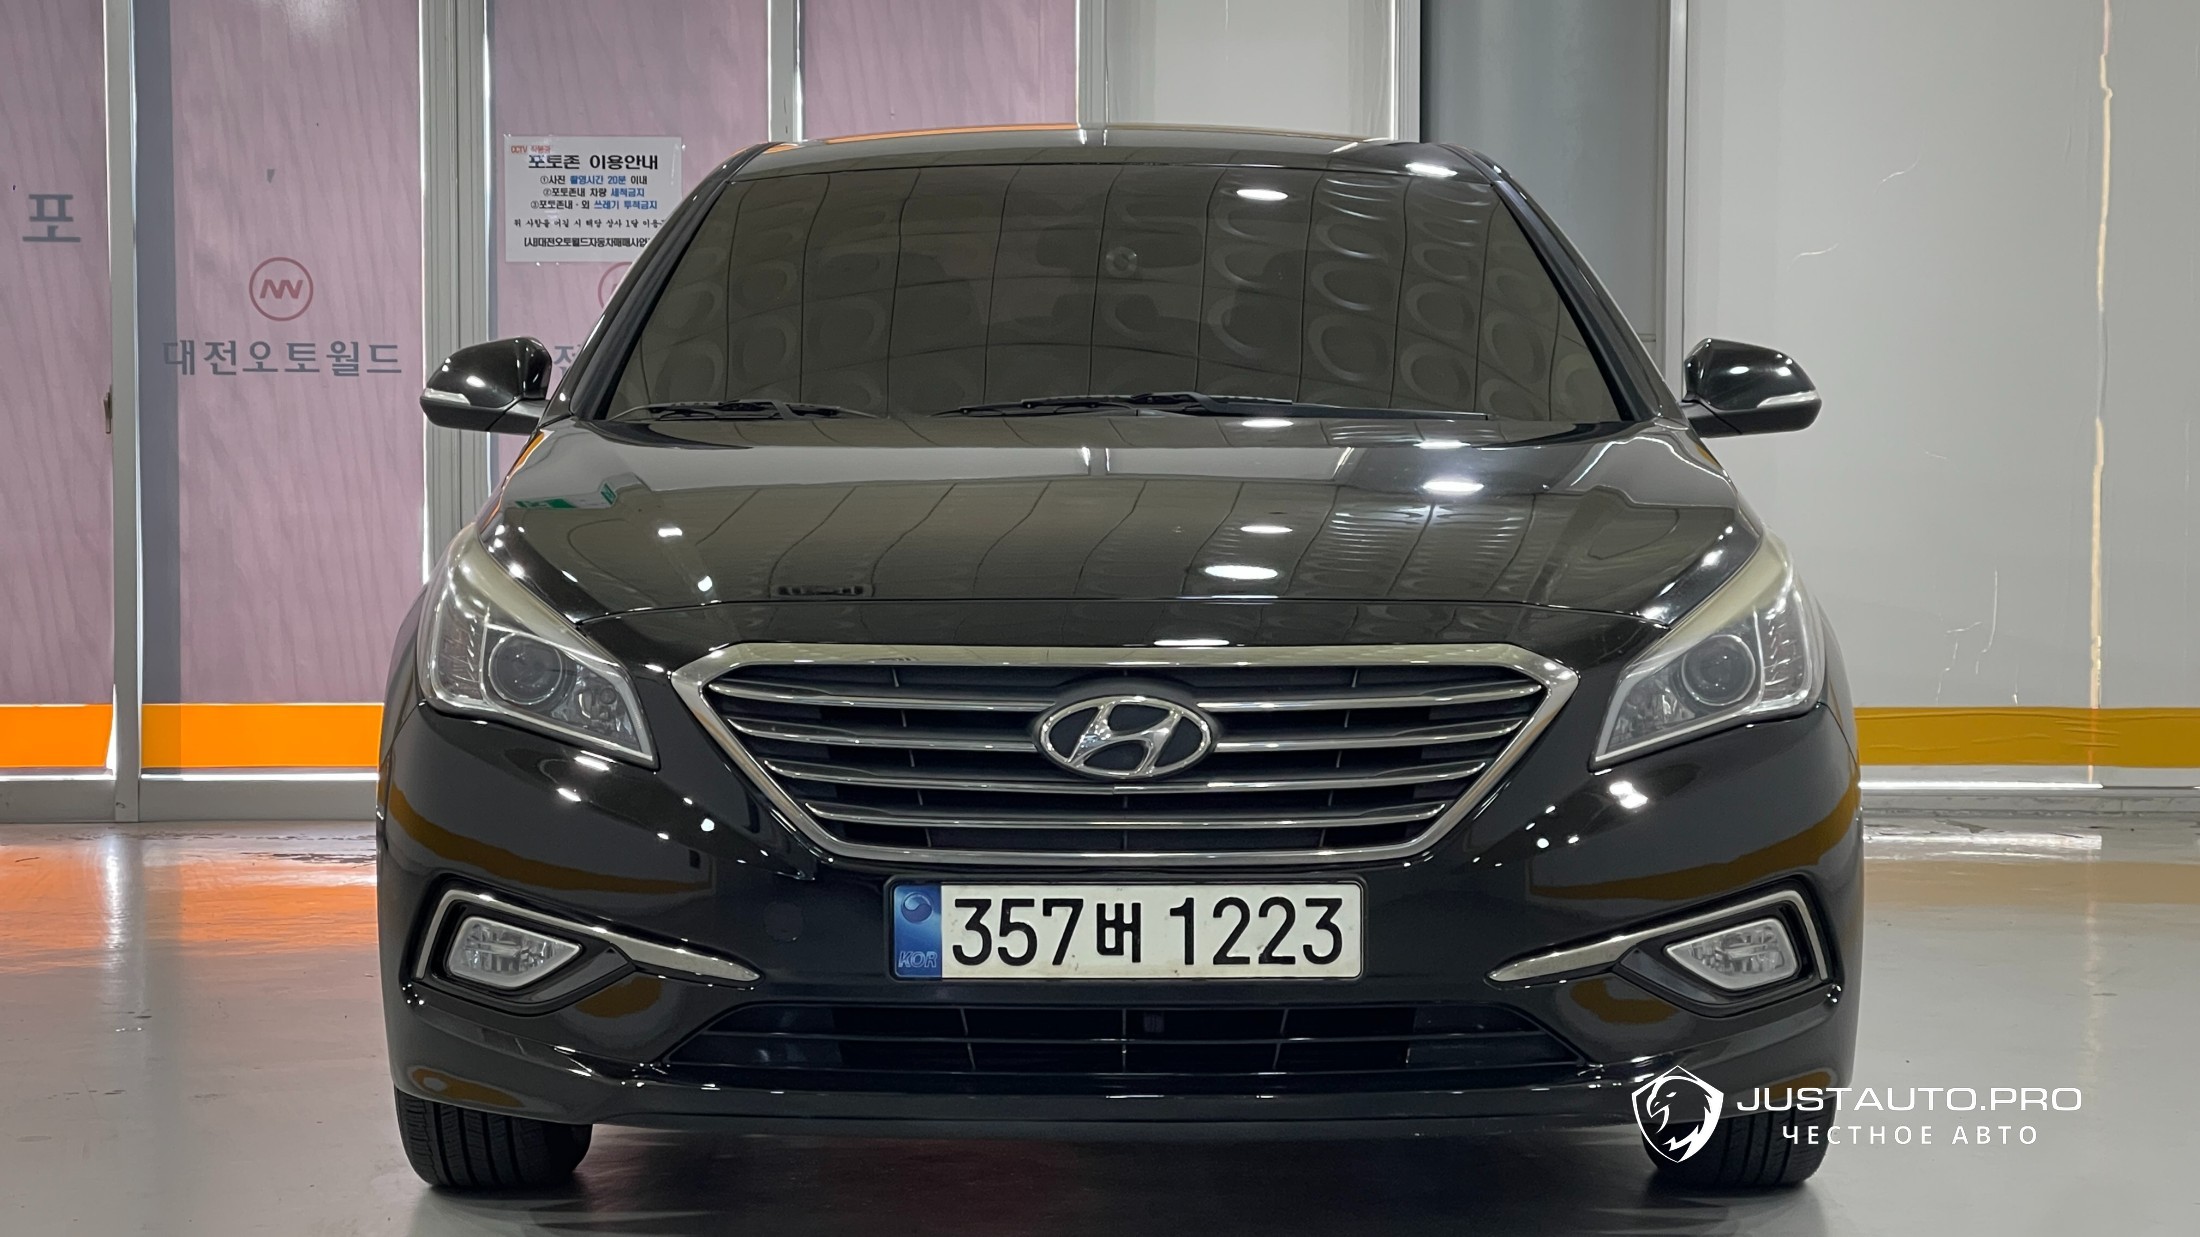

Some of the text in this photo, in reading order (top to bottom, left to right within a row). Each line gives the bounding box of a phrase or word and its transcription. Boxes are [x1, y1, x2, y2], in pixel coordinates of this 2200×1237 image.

[511, 145, 528, 154] CCTV
[528, 154, 658, 170] 포토존 이용안내
[570, 175, 603, 185] 촬영시간
[607, 175, 626, 185] 20분
[630, 175, 647, 185] 이내
[590, 188, 607, 197] 차량
[611, 188, 645, 197] 세척금지
[594, 200, 619, 210] 쓰레기
[623, 200, 657, 210] 투척금지
[22, 194, 81, 242] 포
[525, 219, 550, 228] 사항을
[553, 219, 569, 228] 어길
[574, 219, 582, 228] 시
[585, 219, 602, 228] 해당
[606, 219, 622, 228] 상사
[625, 219, 638, 228] 1달
[642, 219, 666, 228] 이용
[162, 339, 402, 377] 대전오토월드
[1170, 897, 1344, 966] 1223
[897, 950, 938, 969] KOR
